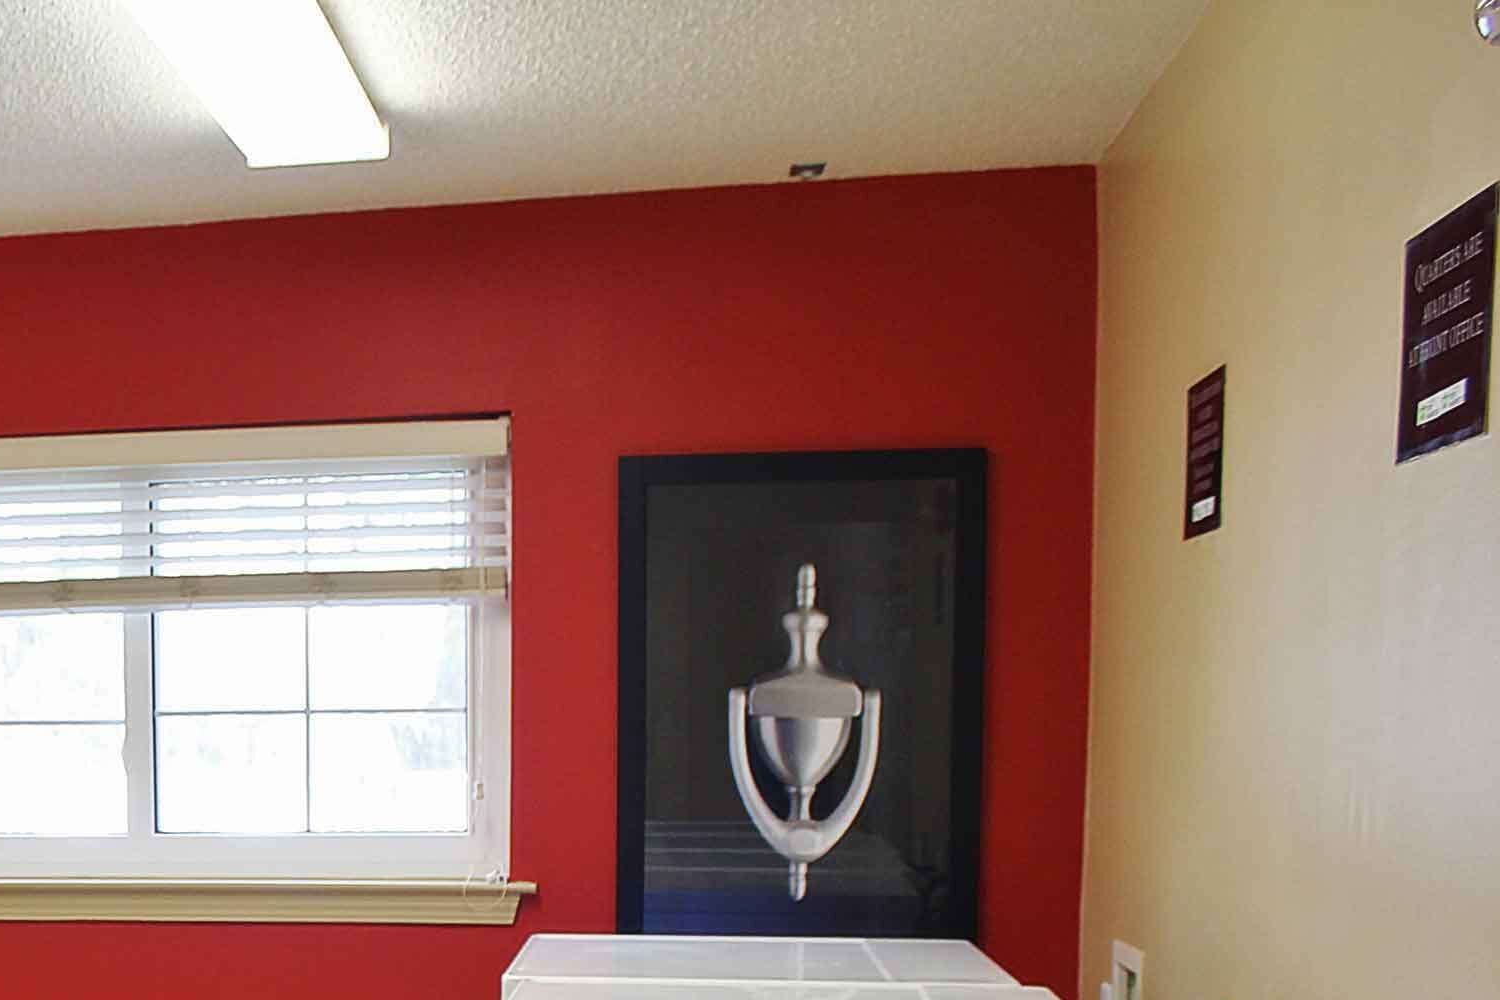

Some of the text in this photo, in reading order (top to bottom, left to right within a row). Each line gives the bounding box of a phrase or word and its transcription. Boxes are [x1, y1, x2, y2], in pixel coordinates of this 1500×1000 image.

[1414, 231, 1483, 293] QUARTERS ARE
[1421, 279, 1471, 325] AVAILABLE
[1419, 329, 1449, 361] FRONT
[1449, 311, 1484, 348] OFFICE
